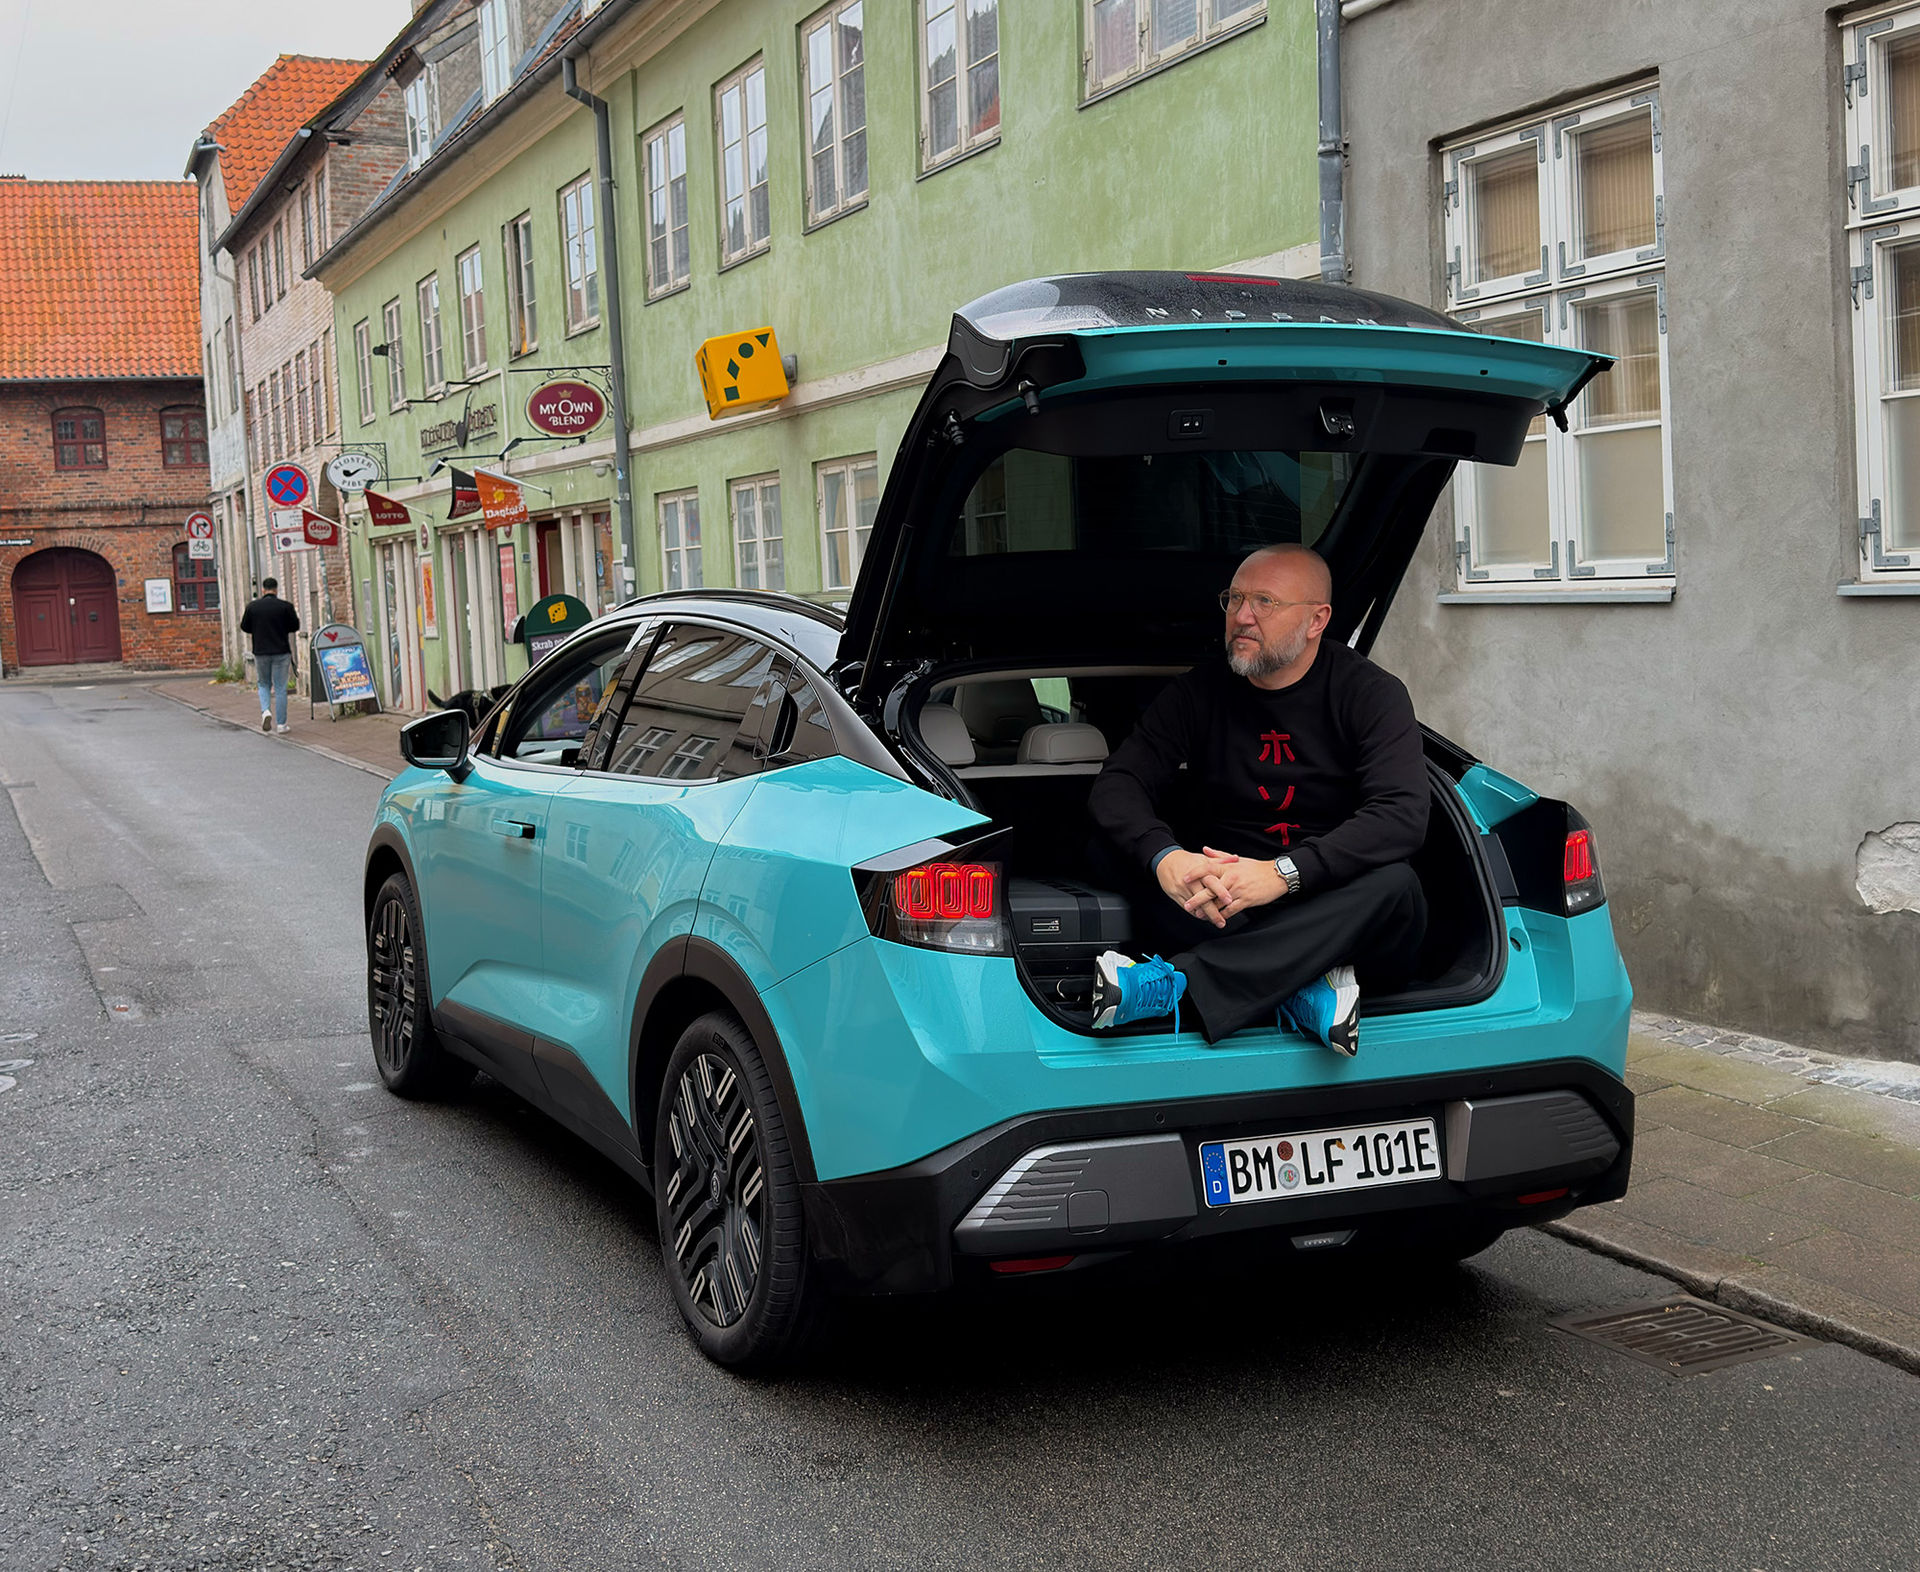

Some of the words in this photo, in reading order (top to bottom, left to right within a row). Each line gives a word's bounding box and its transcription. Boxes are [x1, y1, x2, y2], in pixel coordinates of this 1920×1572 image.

[540, 403, 557, 415] MY
[558, 399, 594, 415] OWN
[549, 415, 585, 426] BLEND
[333, 457, 373, 470] KLOSTER
[310, 522, 330, 531] dao
[532, 639, 554, 651] Skrab
[1213, 1180, 1222, 1193] D
[1228, 1145, 1277, 1194] BM
[1300, 1137, 1344, 1185] LF
[1352, 1127, 1437, 1180] 101E
